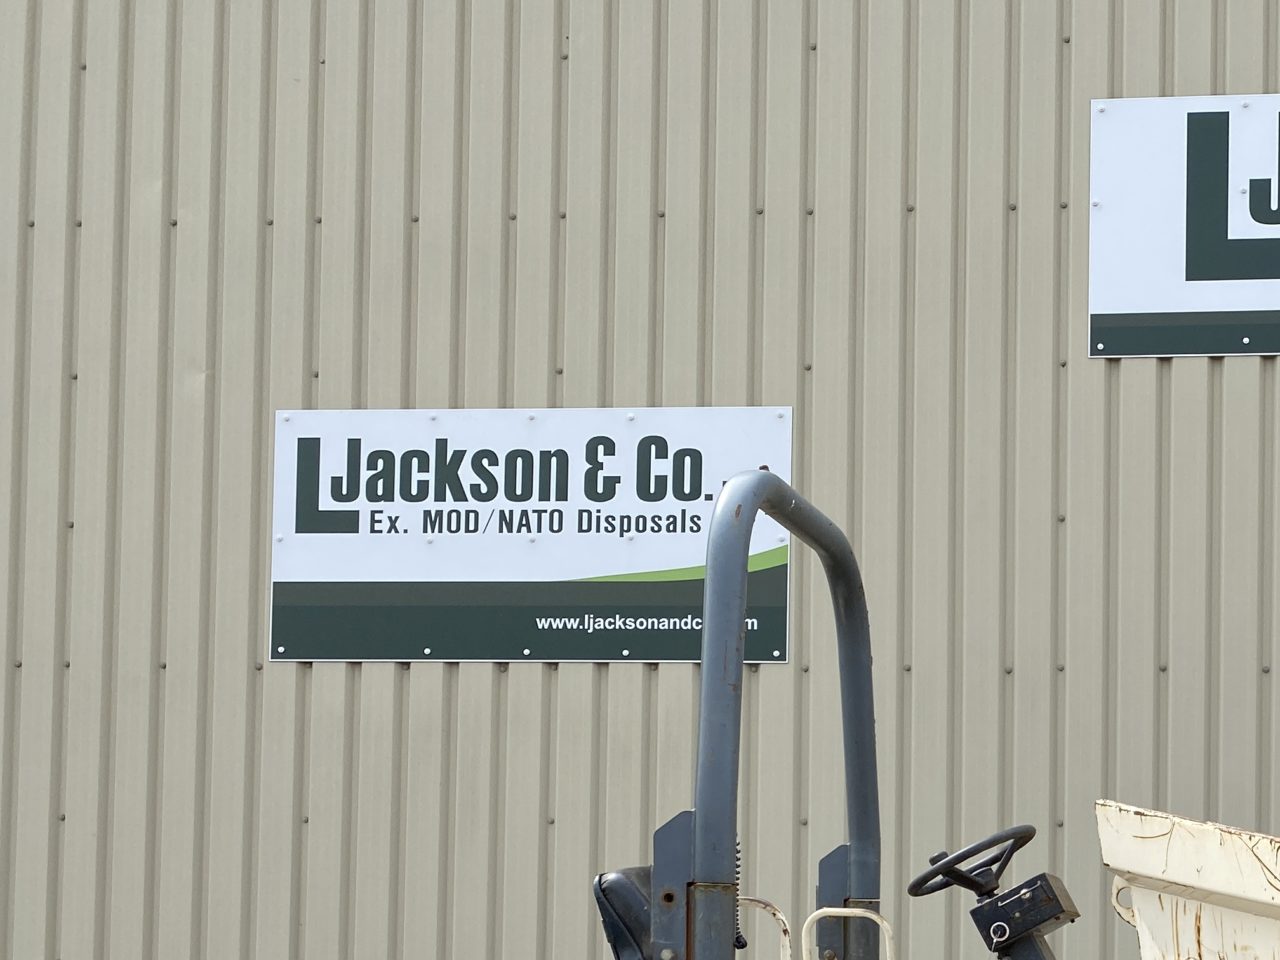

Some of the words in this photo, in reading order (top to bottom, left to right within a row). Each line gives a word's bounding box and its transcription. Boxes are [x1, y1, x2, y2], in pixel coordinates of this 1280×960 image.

[583, 435, 621, 503] &
[635, 435, 714, 503] Co.
[369, 509, 408, 534] Ex.
[422, 508, 564, 534] MOD/NATO
[577, 508, 702, 538] Disposals
[535, 614, 758, 634] www.ljacksonandcm
